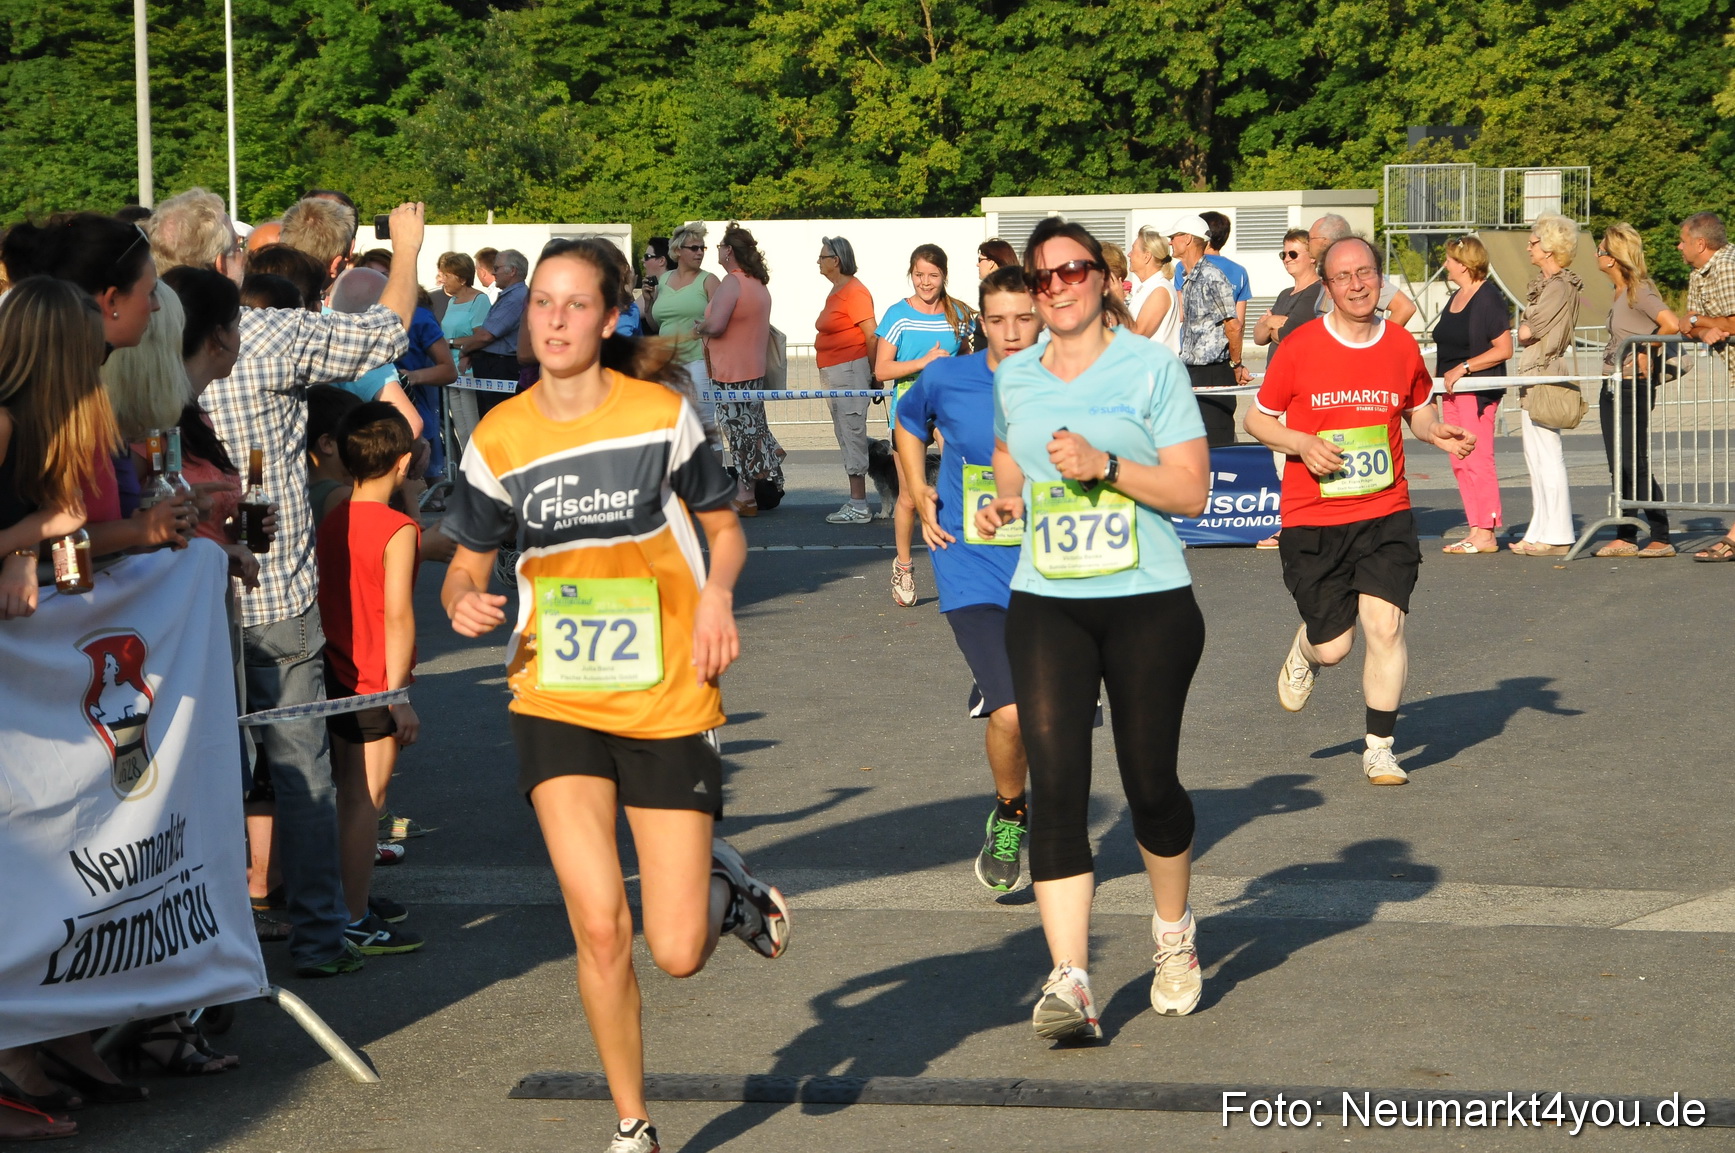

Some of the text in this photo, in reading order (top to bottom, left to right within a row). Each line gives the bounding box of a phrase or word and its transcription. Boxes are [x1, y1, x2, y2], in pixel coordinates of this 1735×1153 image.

[1311, 390, 1389, 407] NEUMARKT
[1328, 449, 1388, 480] 330
[541, 488, 639, 521] Fischer
[1204, 487, 1280, 514] isch
[553, 509, 635, 531] AUTOMOBILE
[1035, 512, 1130, 553] 1379
[555, 618, 639, 661] 372
[69, 812, 186, 897] Neumarkter
[39, 869, 220, 986] Lammsbräu
